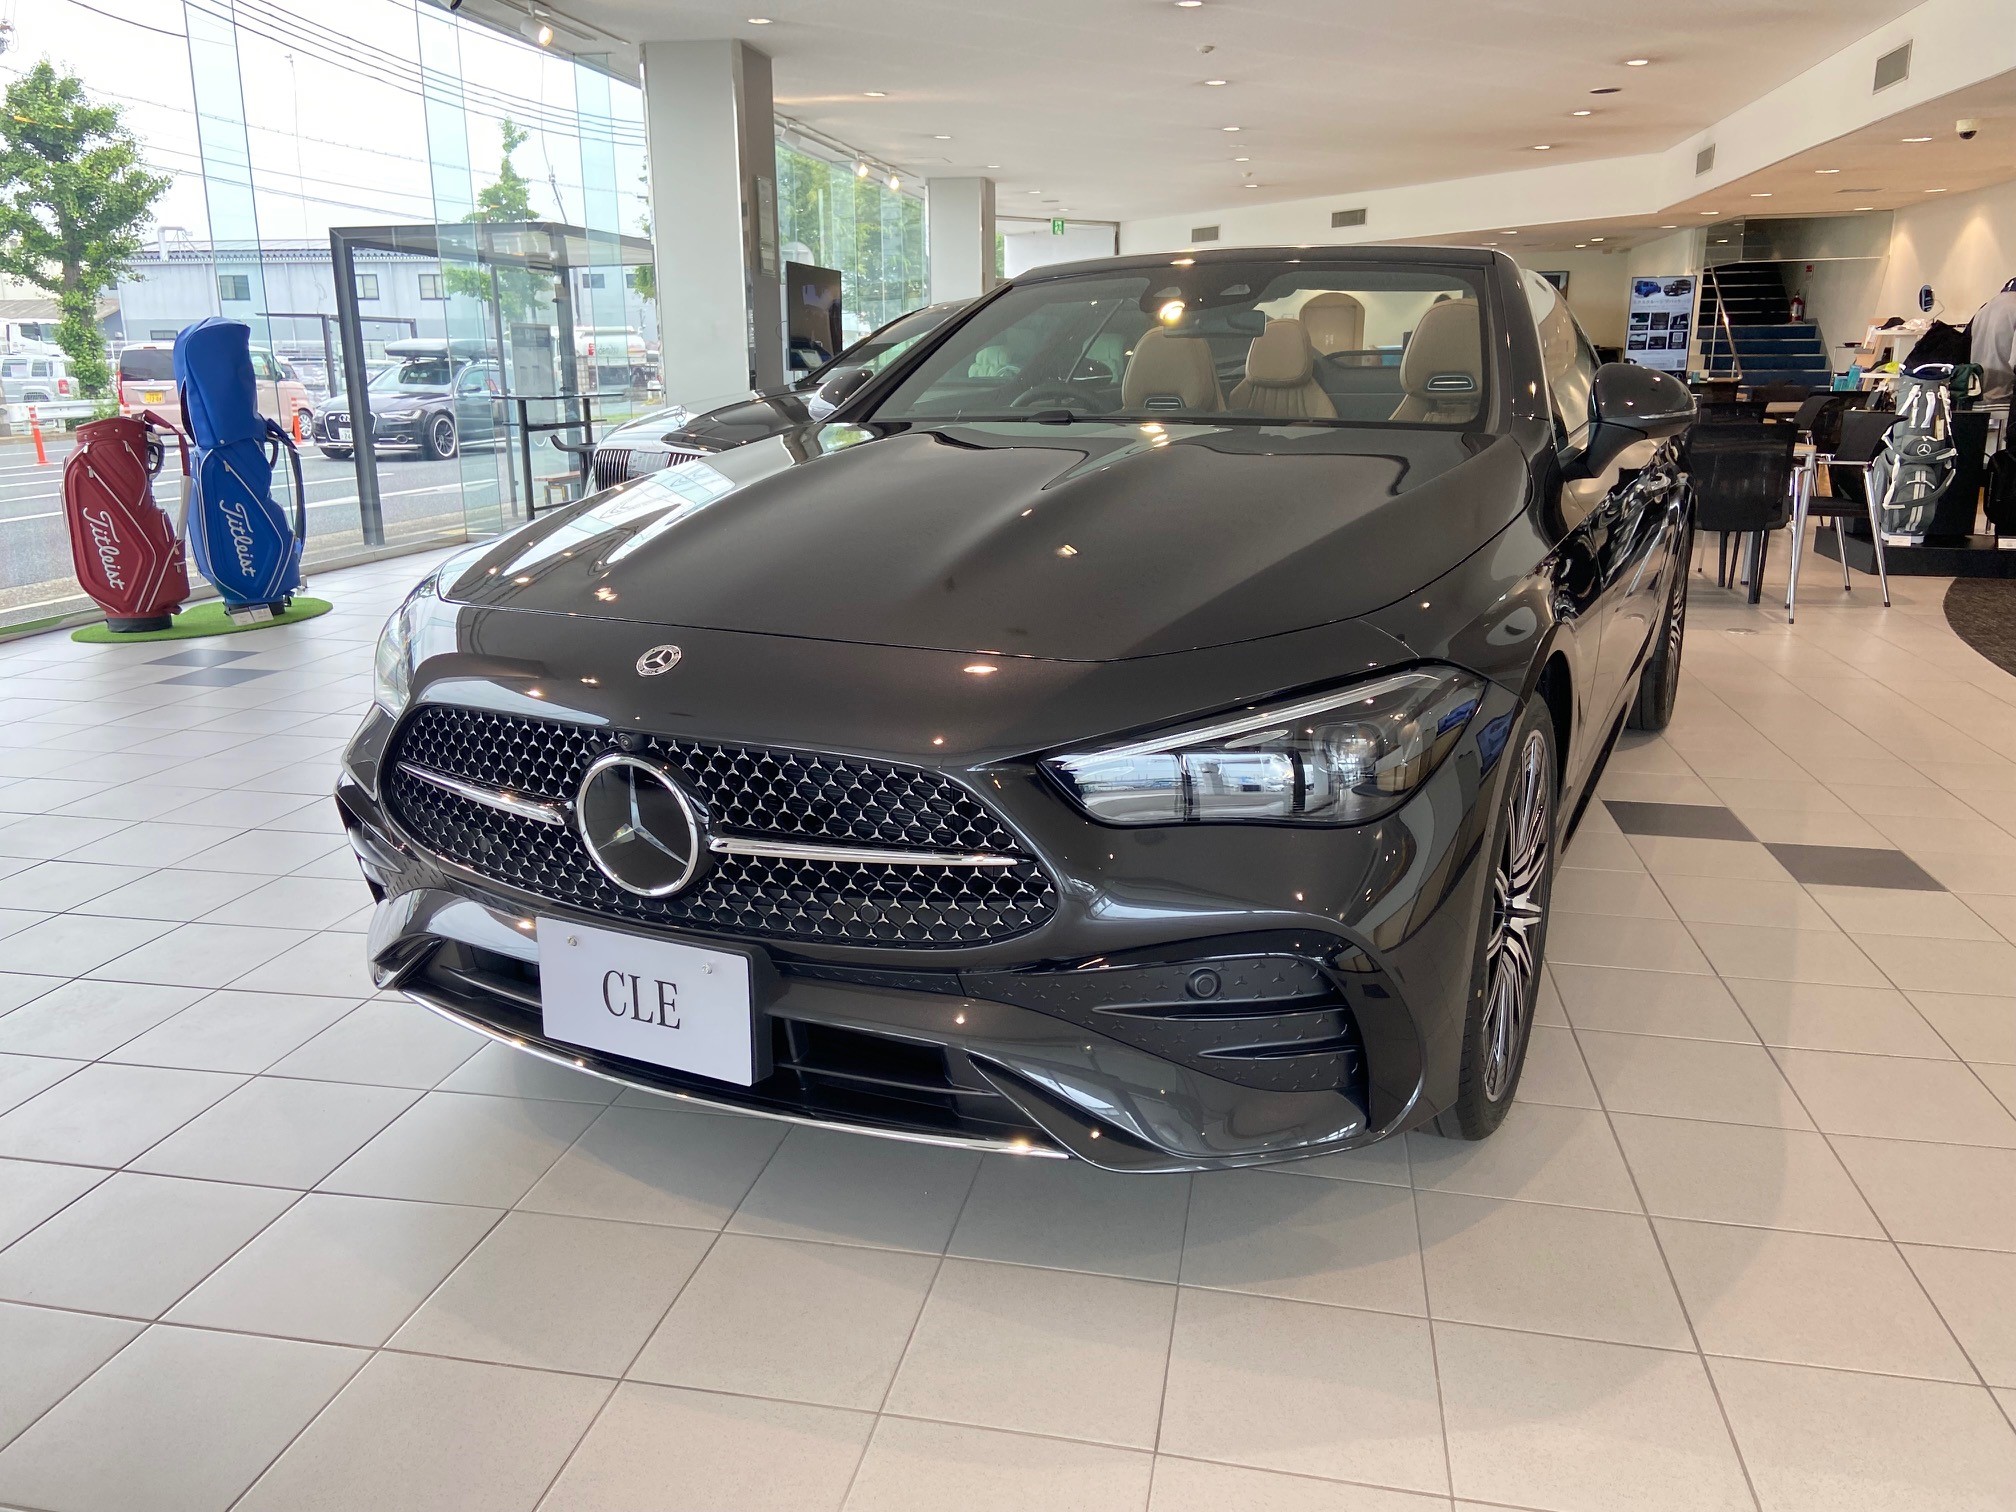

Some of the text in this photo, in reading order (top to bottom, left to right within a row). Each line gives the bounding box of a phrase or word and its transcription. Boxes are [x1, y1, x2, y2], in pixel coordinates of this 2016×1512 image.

[83, 507, 125, 590] Titleist
[219, 499, 257, 577] Titleist
[602, 969, 681, 1030] CLE
